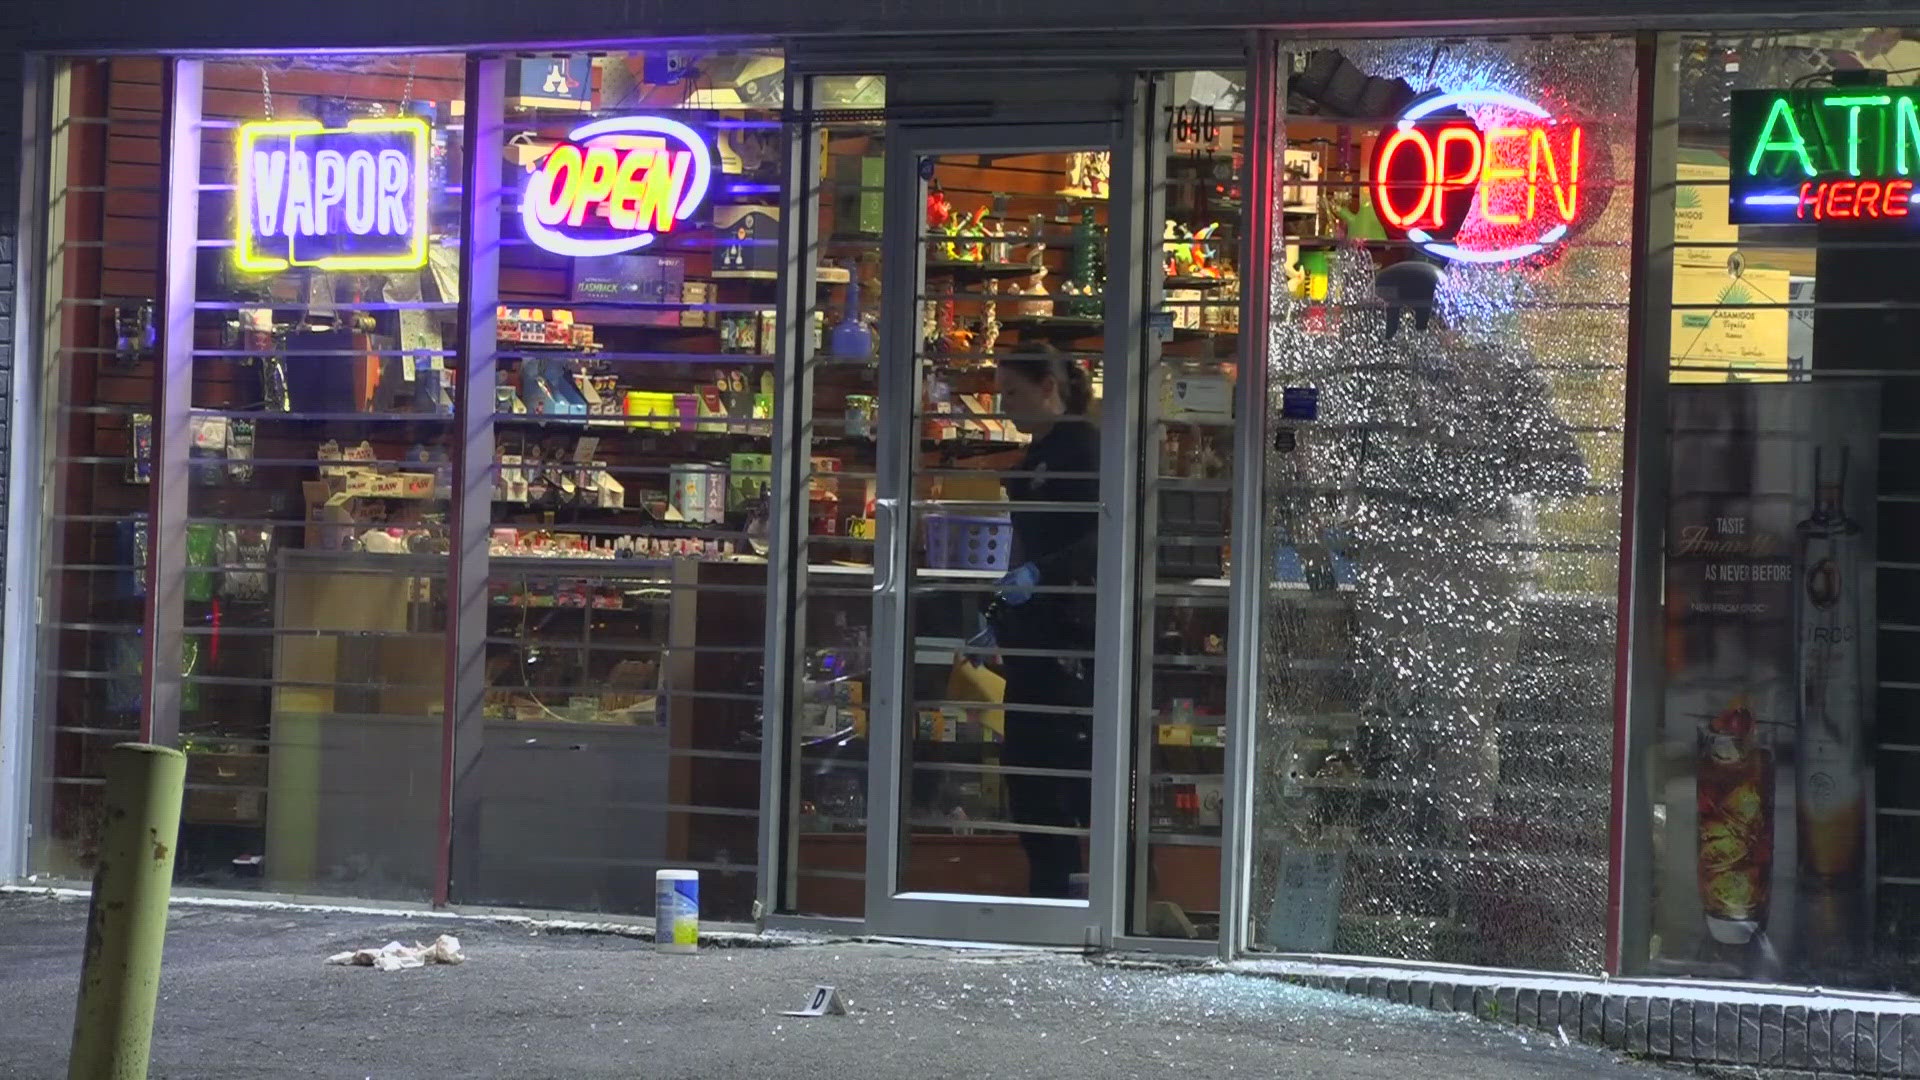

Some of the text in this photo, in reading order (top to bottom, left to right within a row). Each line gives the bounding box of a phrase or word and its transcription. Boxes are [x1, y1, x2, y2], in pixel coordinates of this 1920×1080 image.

[1164, 105, 1214, 142] 7640
[254, 148, 410, 237] VAPOR
[534, 142, 692, 232] OPEN
[1377, 125, 1581, 228] OPEN
[1797, 182, 1913, 219] HERE
[1713, 309, 1756, 320] CASAMIGOS
[377, 482, 398, 492] RAW
[1716, 517, 1745, 535] TASTE
[1705, 564, 1792, 582] AS NEVER BEFORE
